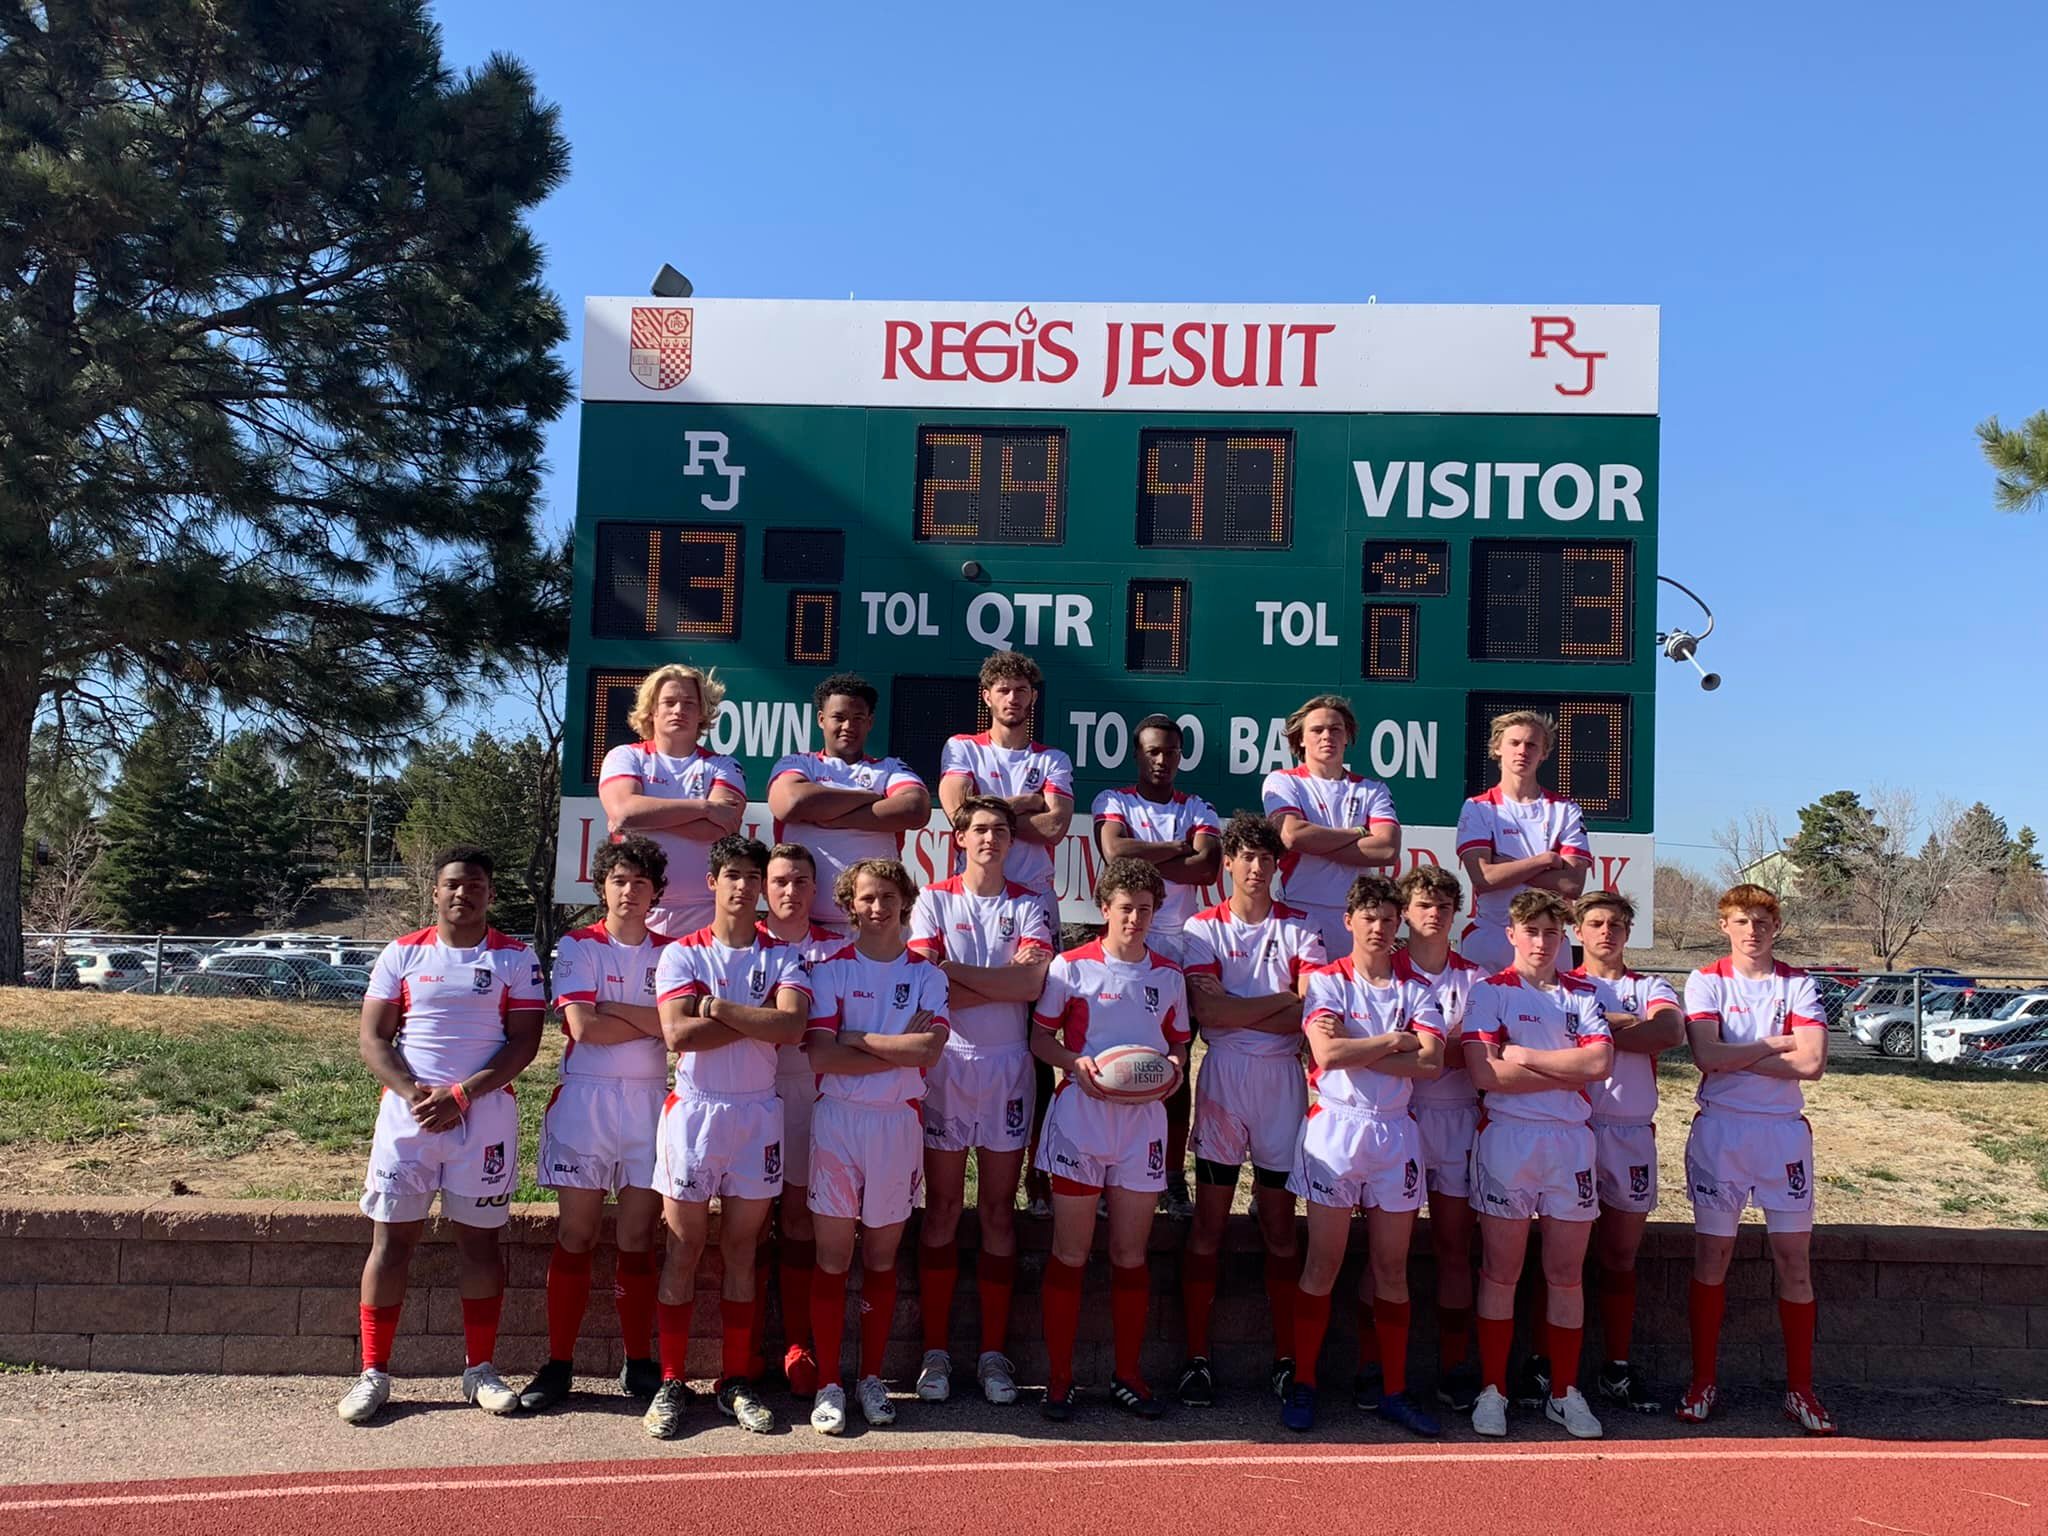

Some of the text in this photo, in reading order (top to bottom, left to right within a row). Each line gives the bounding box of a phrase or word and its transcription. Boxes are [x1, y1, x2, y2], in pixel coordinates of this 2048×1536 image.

[882, 306, 1336, 398] REGIS JESUIT
[1530, 315, 1608, 396] RJ
[683, 430, 746, 512] RJ
[1353, 460, 1644, 522] VISITOR
[861, 591, 1094, 651] TOL QTR
[1256, 601, 1339, 646] TOL
[697, 700, 813, 757] OWN
[1069, 711, 1128, 769] TO
[1370, 719, 1438, 779] ON
[419, 975, 445, 983] BLK
[1518, 1014, 1542, 1023] BLK
[553, 1163, 579, 1174] BLK
[1056, 1154, 1079, 1168] BLK
[1311, 1180, 1334, 1195] BLK
[1486, 1193, 1510, 1206] BLK
